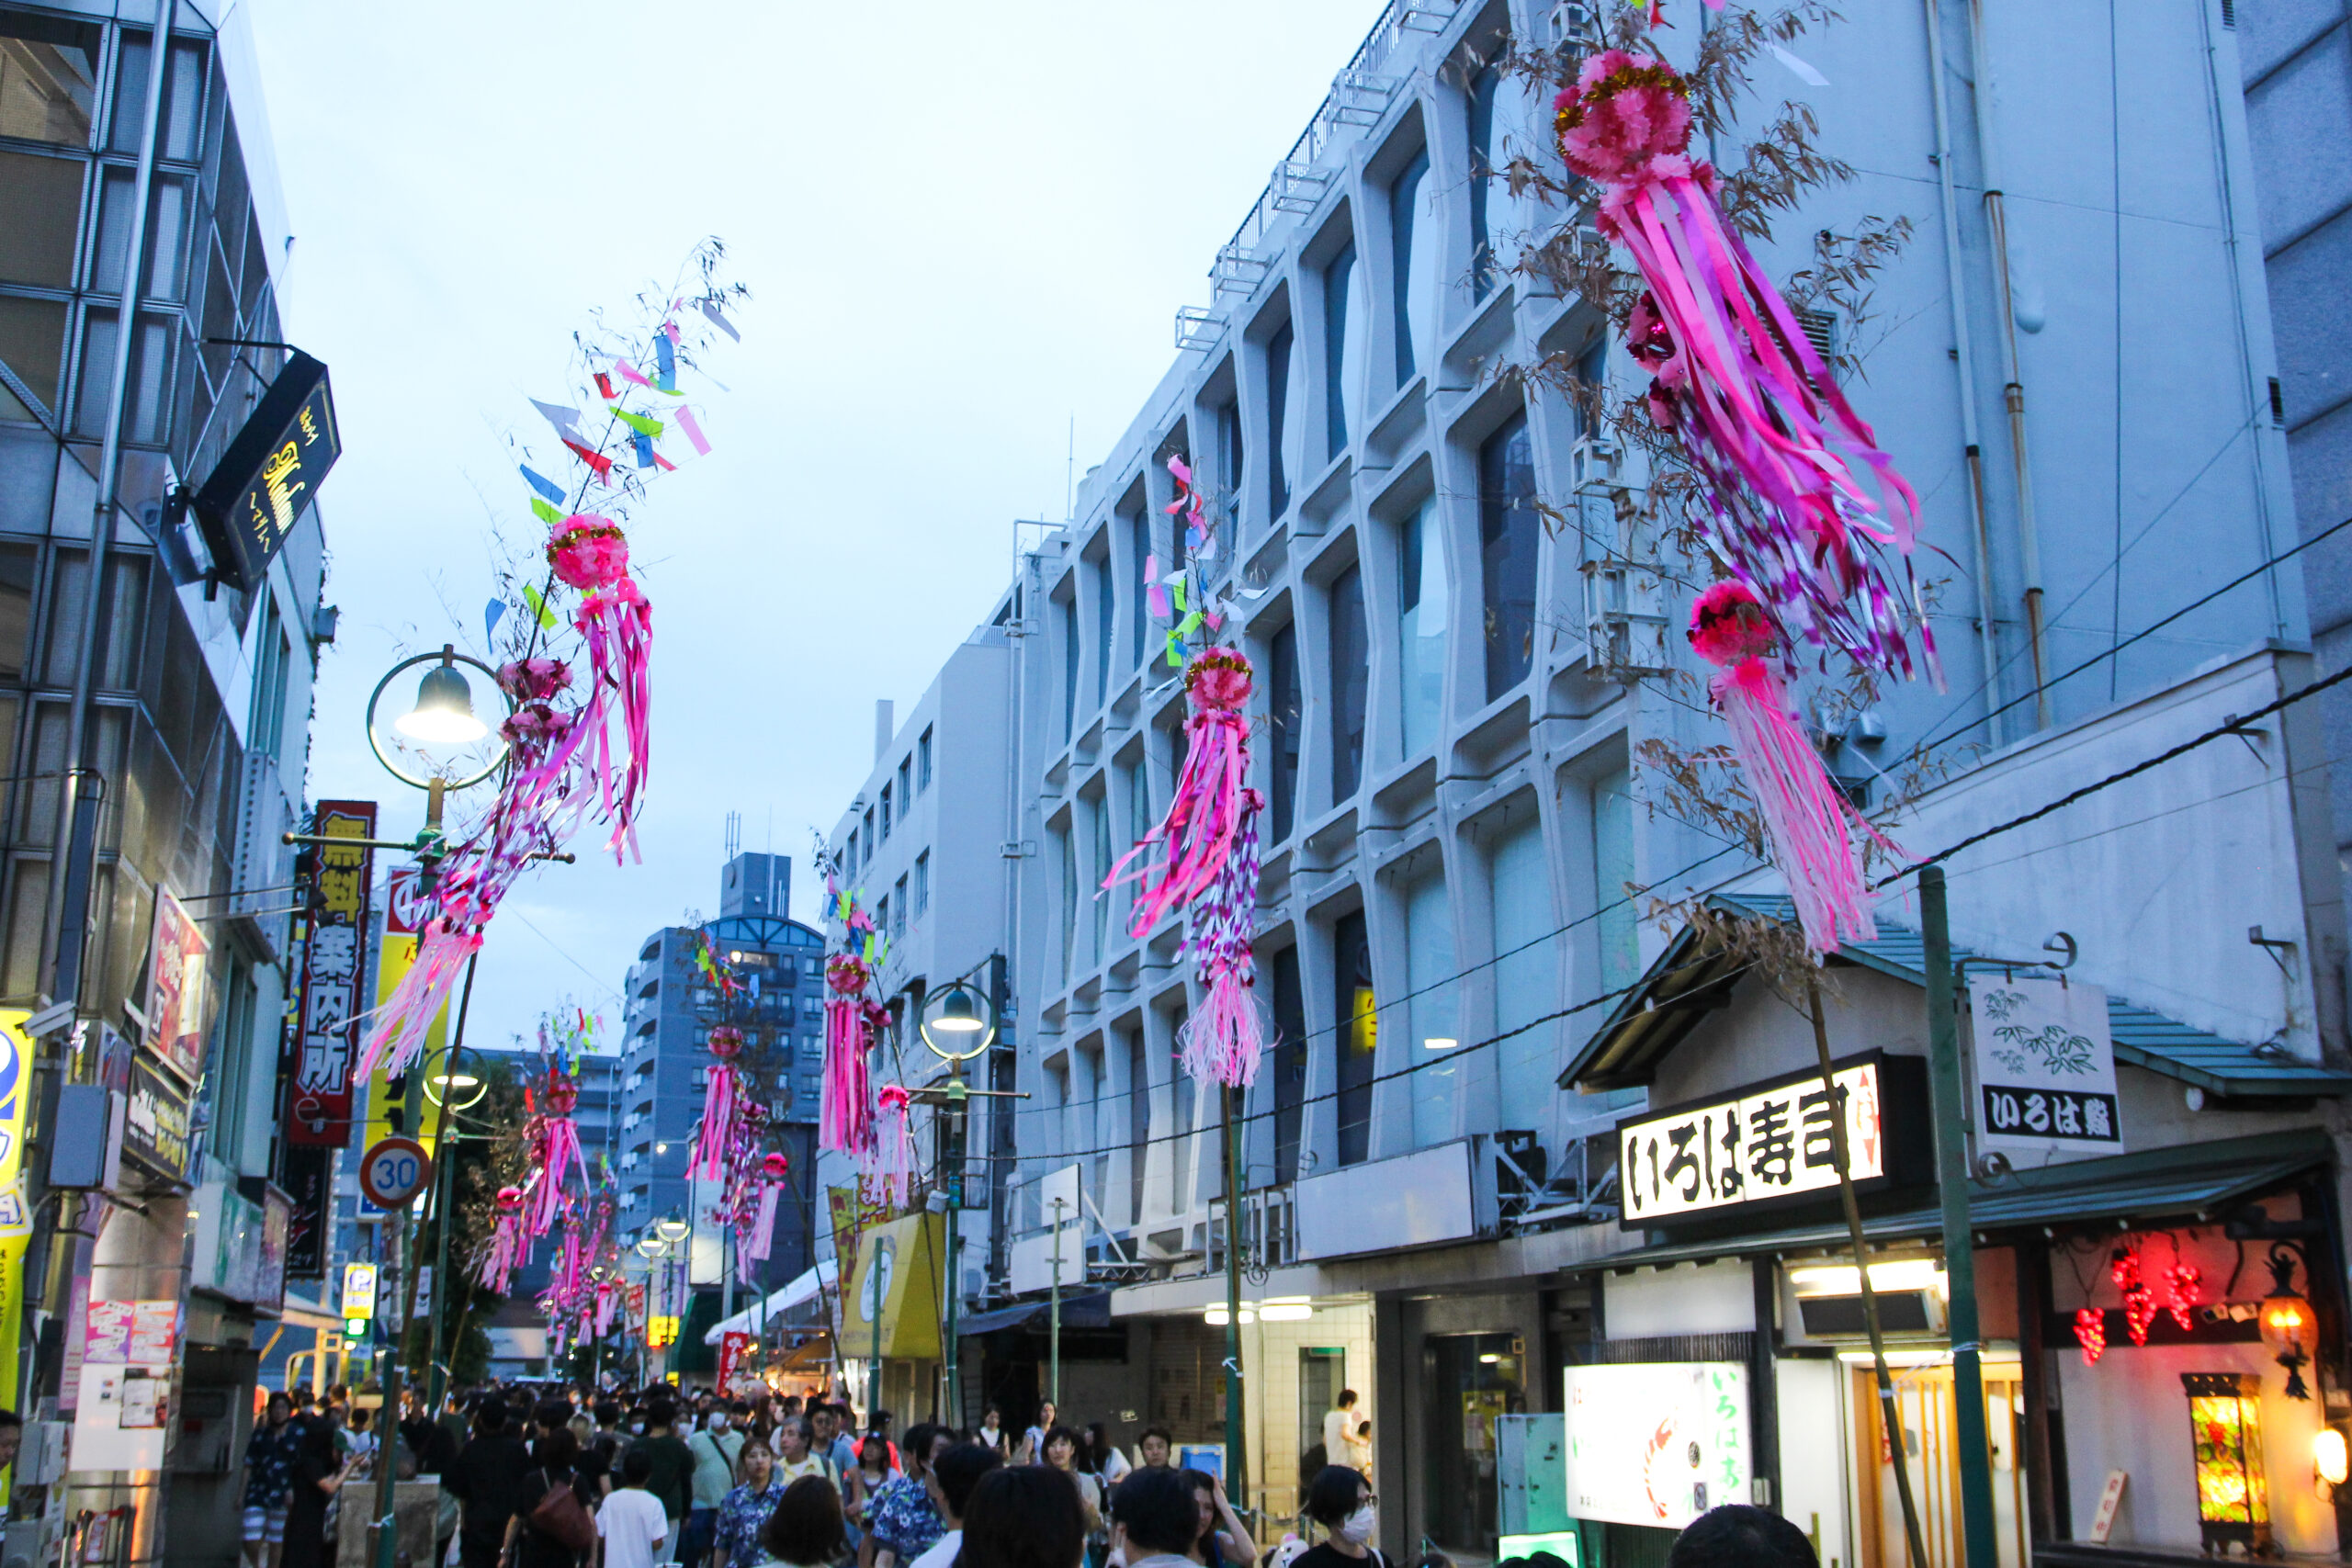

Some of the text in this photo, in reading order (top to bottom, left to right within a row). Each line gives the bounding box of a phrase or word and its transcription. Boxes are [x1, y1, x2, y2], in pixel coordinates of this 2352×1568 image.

[263, 441, 305, 535] Madam
[299, 815, 368, 1093] 無料案内所
[376, 1158, 417, 1189] 30
[1627, 1082, 1850, 1211] いろは寿司
[351, 1269, 371, 1292] P
